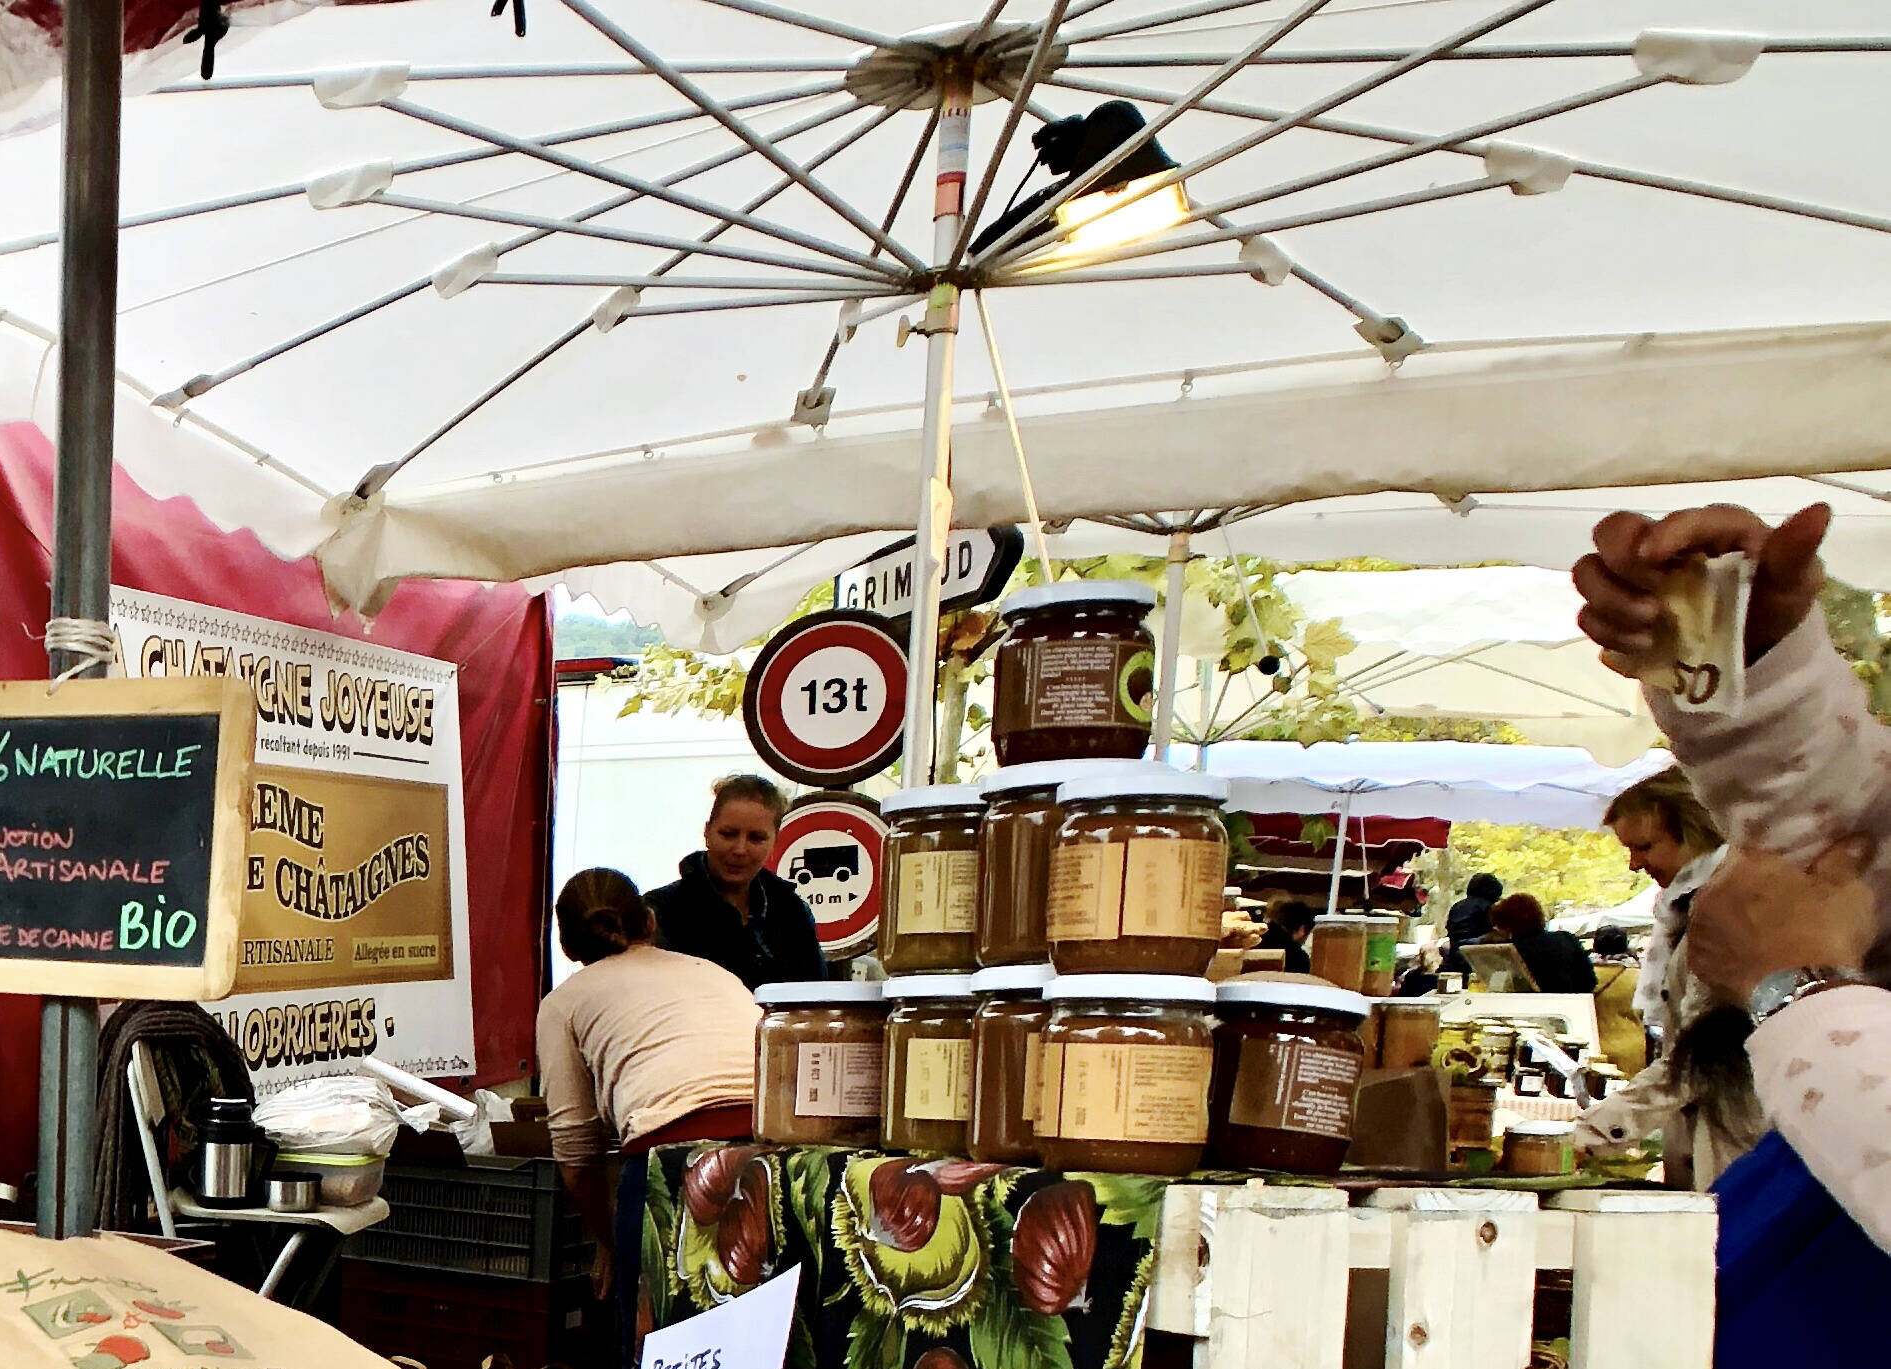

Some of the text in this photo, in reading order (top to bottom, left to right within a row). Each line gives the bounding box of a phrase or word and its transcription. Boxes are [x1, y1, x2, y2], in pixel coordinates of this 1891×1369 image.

[320, 669, 435, 746] JOYEUSE
[800, 677, 868, 716] 13t
[15, 743, 201, 781] NATURELLE
[303, 739, 330, 761] depuis
[332, 743, 351, 760] 1991
[251, 783, 324, 850] EME
[247, 834, 431, 920] E CHÂTAIGNES
[806, 892, 842, 905] 10 m
[241, 938, 335, 965] RTISANALE
[392, 945, 405, 959] en
[408, 944, 437, 959] sucre
